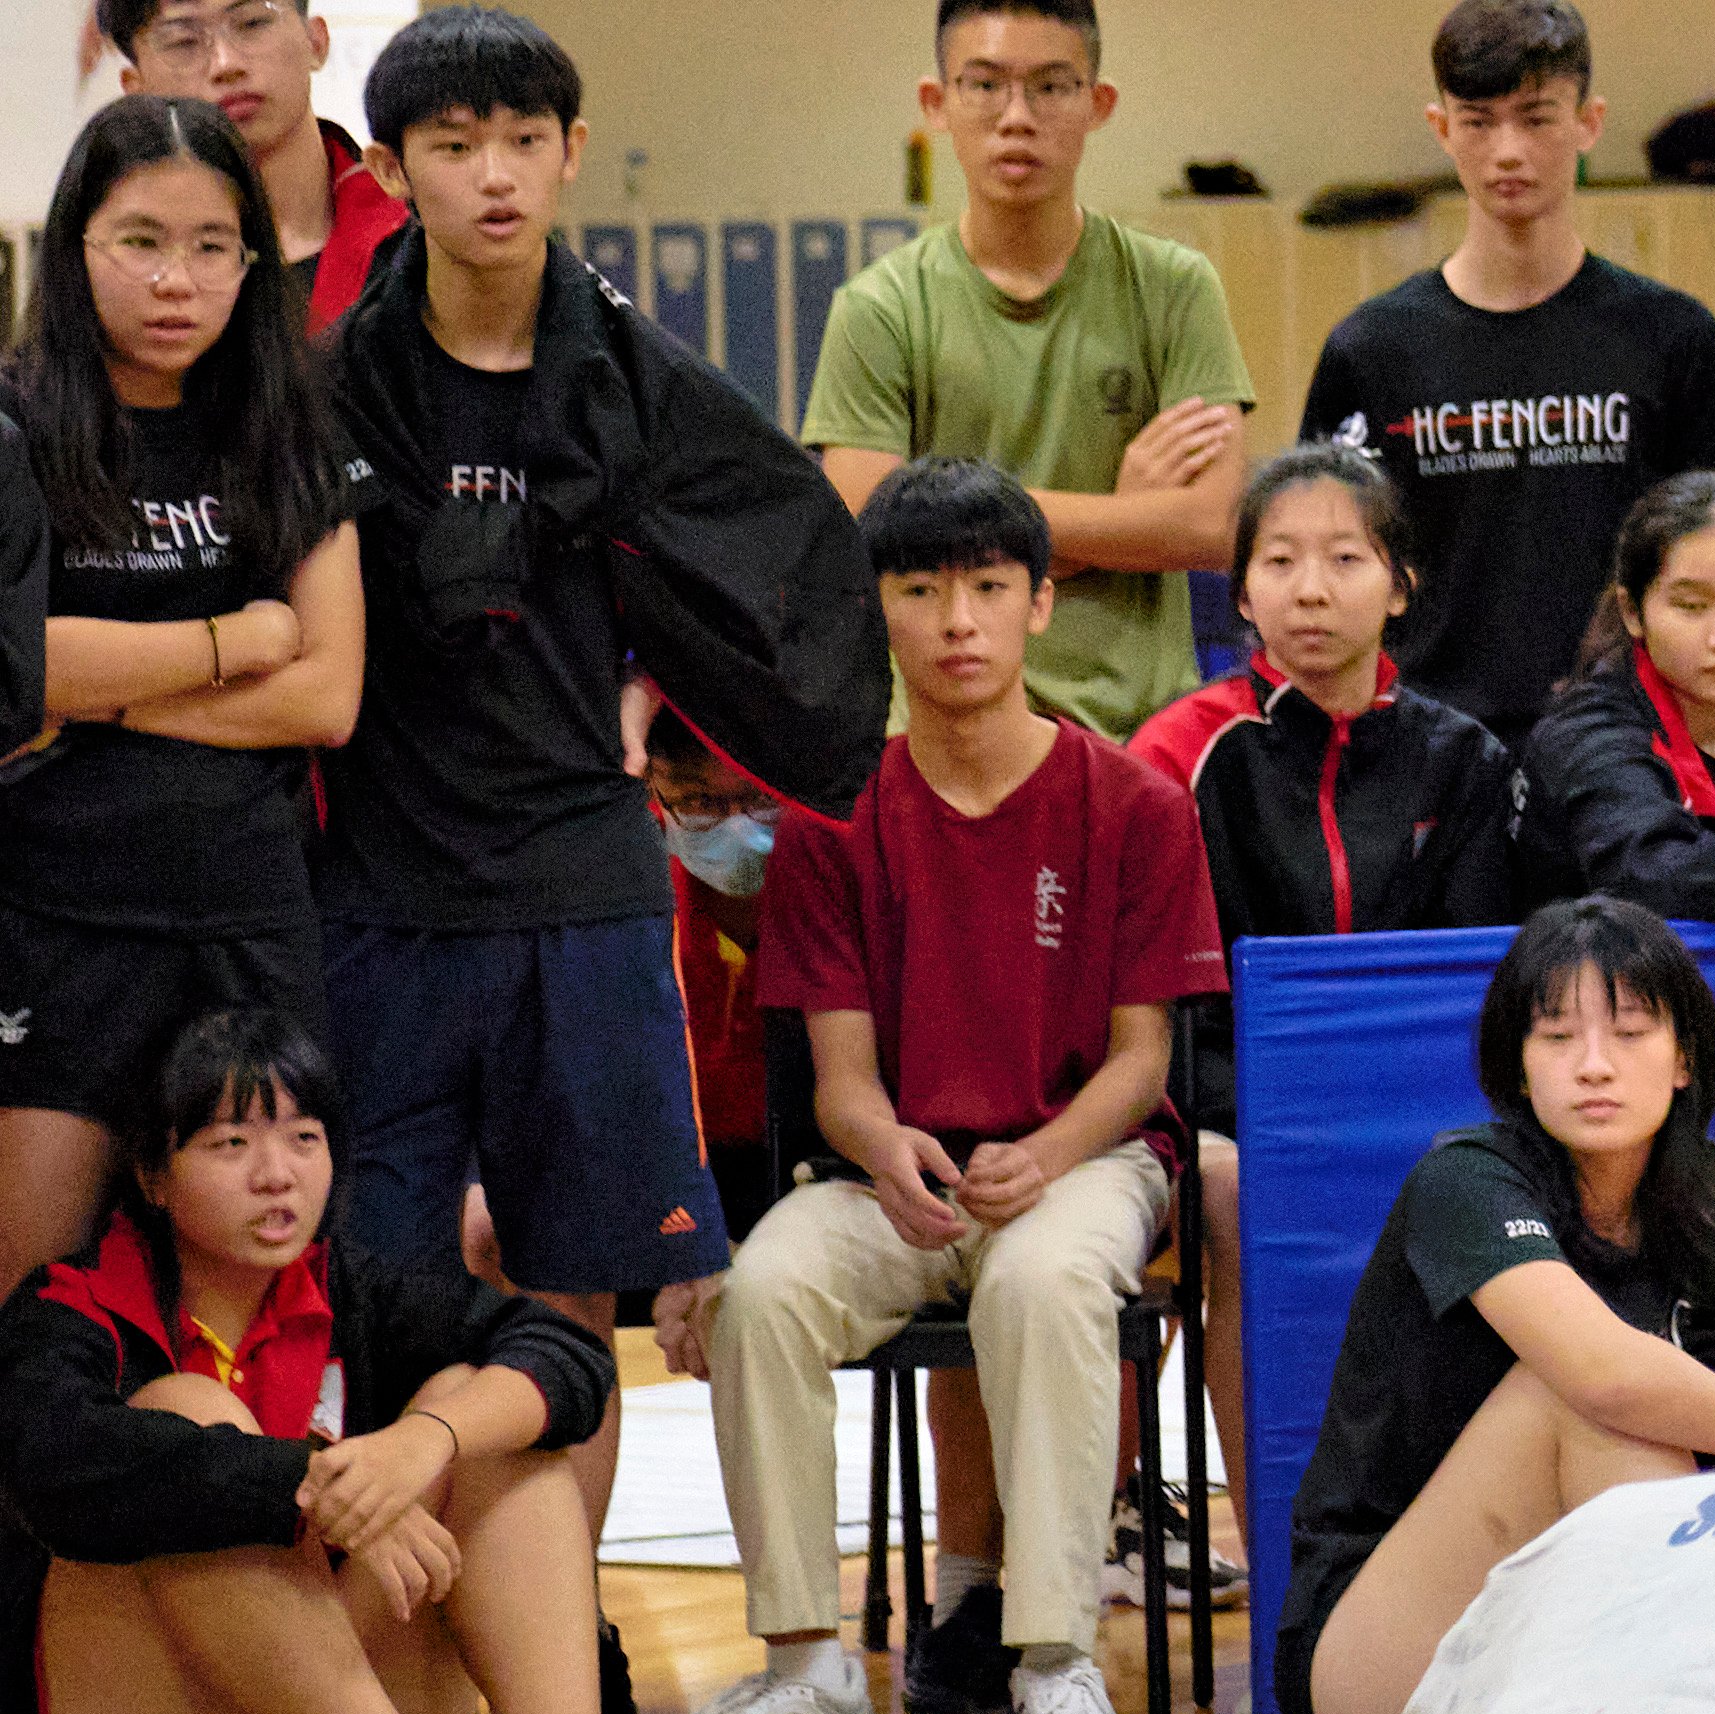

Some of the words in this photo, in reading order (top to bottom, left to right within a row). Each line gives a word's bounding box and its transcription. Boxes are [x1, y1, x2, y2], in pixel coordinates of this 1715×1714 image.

[1413, 402, 1463, 456] HC
[1470, 391, 1630, 450] FENCING
[1528, 446, 1579, 467] HEARTS
[126, 550, 184, 572] DRAWN
